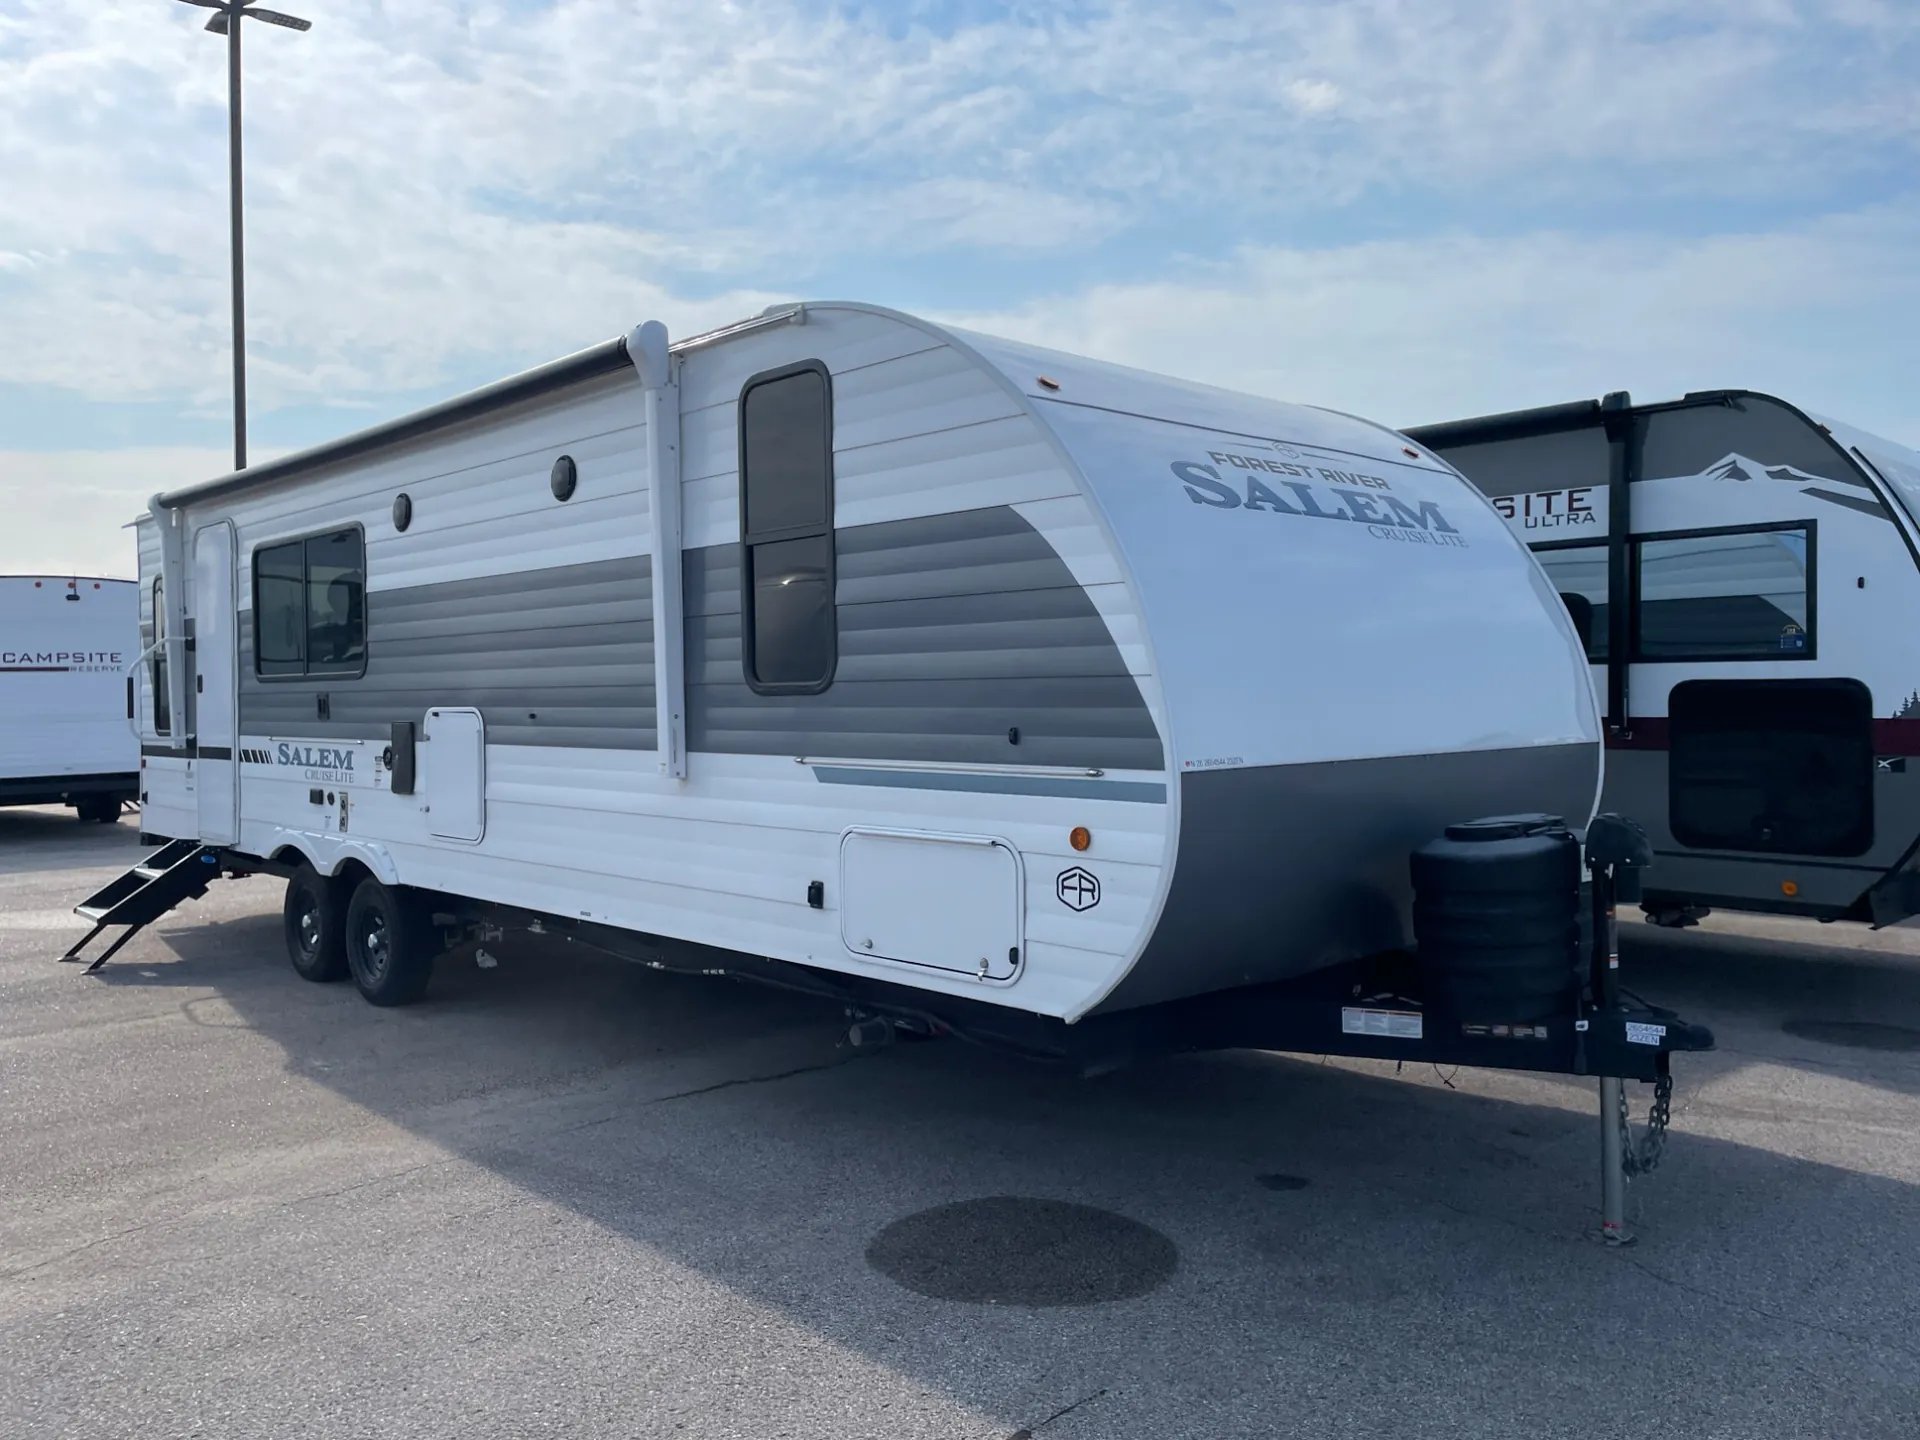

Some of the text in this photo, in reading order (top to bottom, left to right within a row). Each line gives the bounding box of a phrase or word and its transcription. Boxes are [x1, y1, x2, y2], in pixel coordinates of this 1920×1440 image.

[1207, 450, 1313, 479] FOREST
[1315, 467, 1391, 490] RIVER
[1170, 460, 1459, 533] SALEM
[1525, 512, 1596, 529] ULTRA
[2, 652, 122, 664] CAMPSITE
[277, 743, 354, 771] SALEM
